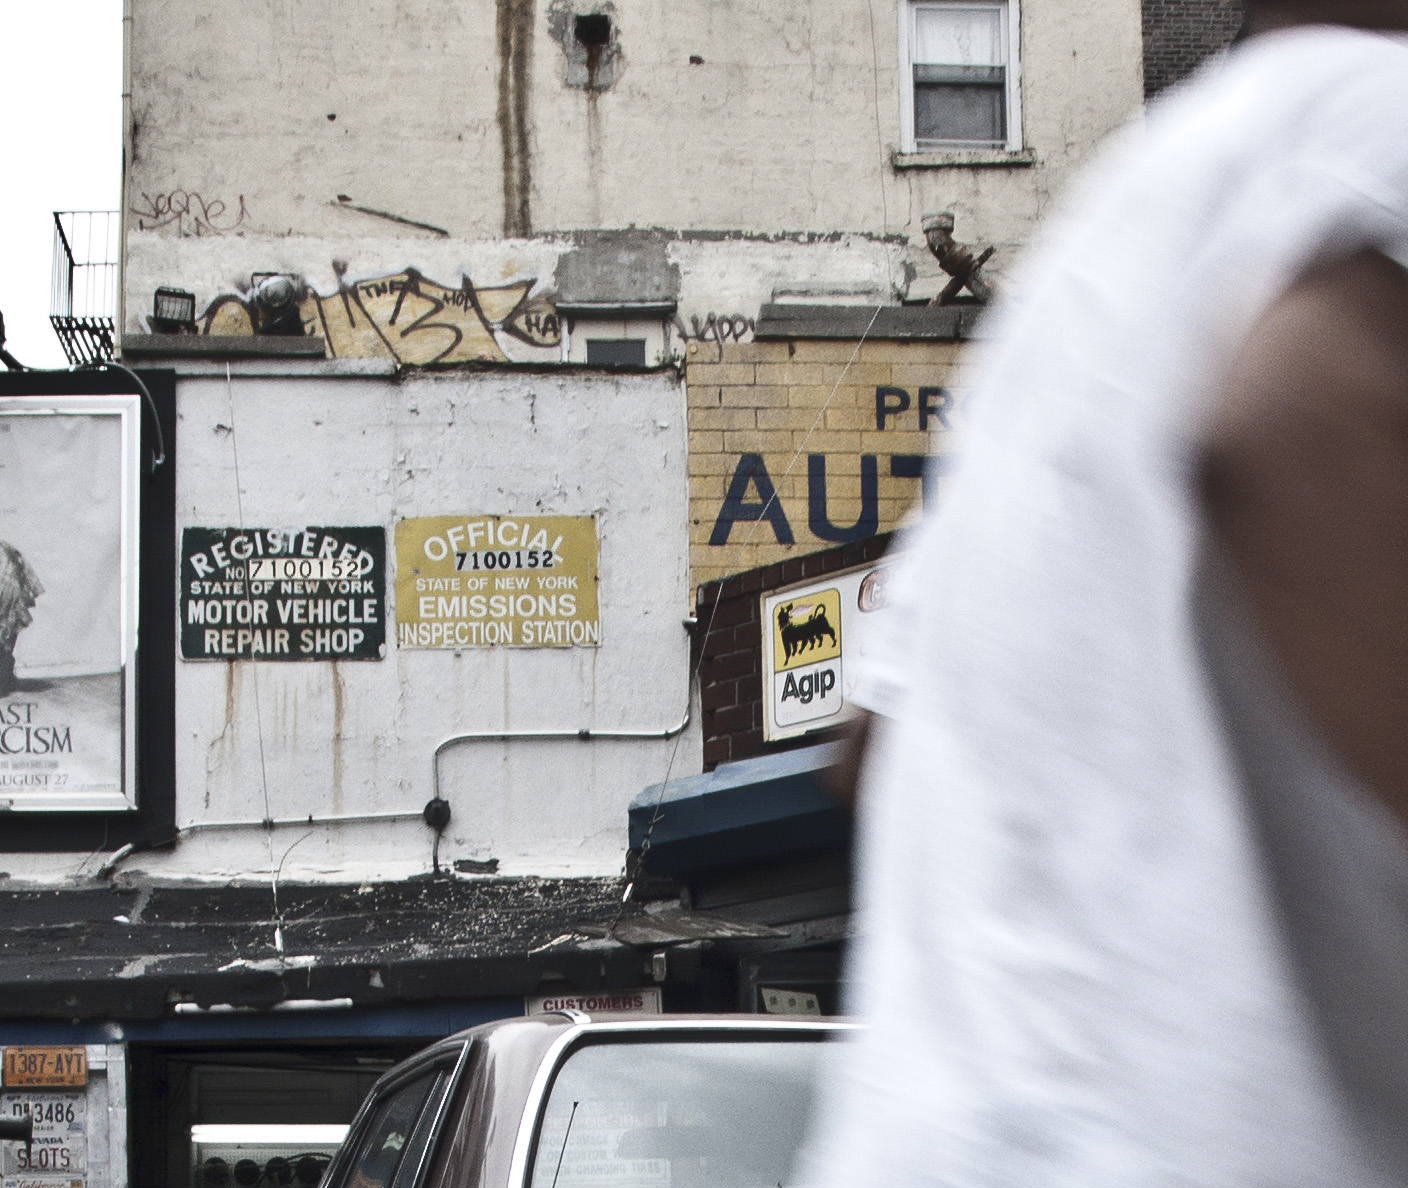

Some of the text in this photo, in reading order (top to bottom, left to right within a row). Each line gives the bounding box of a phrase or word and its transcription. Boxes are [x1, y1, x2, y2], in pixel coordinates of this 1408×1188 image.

[189, 529, 374, 579] REGISTERED
[423, 521, 564, 563] OFFICIAL
[250, 560, 360, 579] 7100152
[455, 550, 554, 571] 7100152
[190, 580, 375, 595] STATE OF NEW YORK
[415, 576, 579, 592] STATE OF NEW YORK
[187, 598, 378, 625] MOTOR VEHICLE
[418, 594, 577, 619] EMISSIONS
[204, 627, 365, 655] REPAIR SHOP
[398, 620, 598, 646] INSPECTION STATION
[781, 668, 836, 704] Agip
[54, 774, 69, 785] 27
[542, 995, 644, 1013] CUSTOMERS
